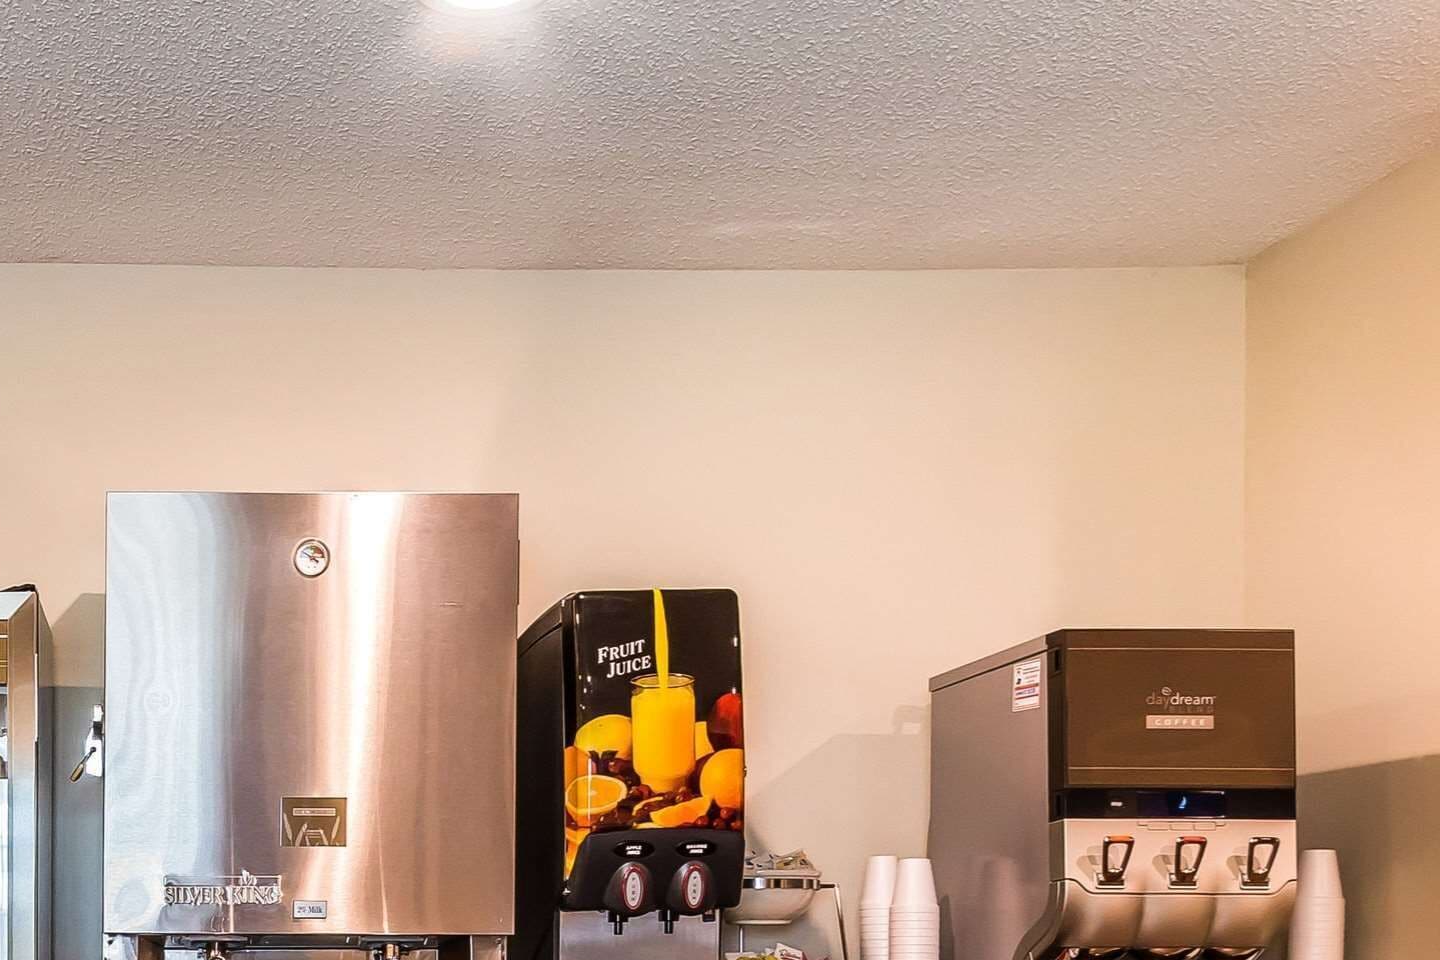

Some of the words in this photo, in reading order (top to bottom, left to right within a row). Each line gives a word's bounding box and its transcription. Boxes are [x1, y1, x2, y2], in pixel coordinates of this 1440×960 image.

[597, 639, 646, 664] FRUIT
[606, 655, 652, 679] JUICE
[1145, 691, 1214, 709] daydream
[1154, 718, 1206, 727] COFFEE
[164, 885, 226, 906] SILVER
[226, 885, 284, 905] KING
